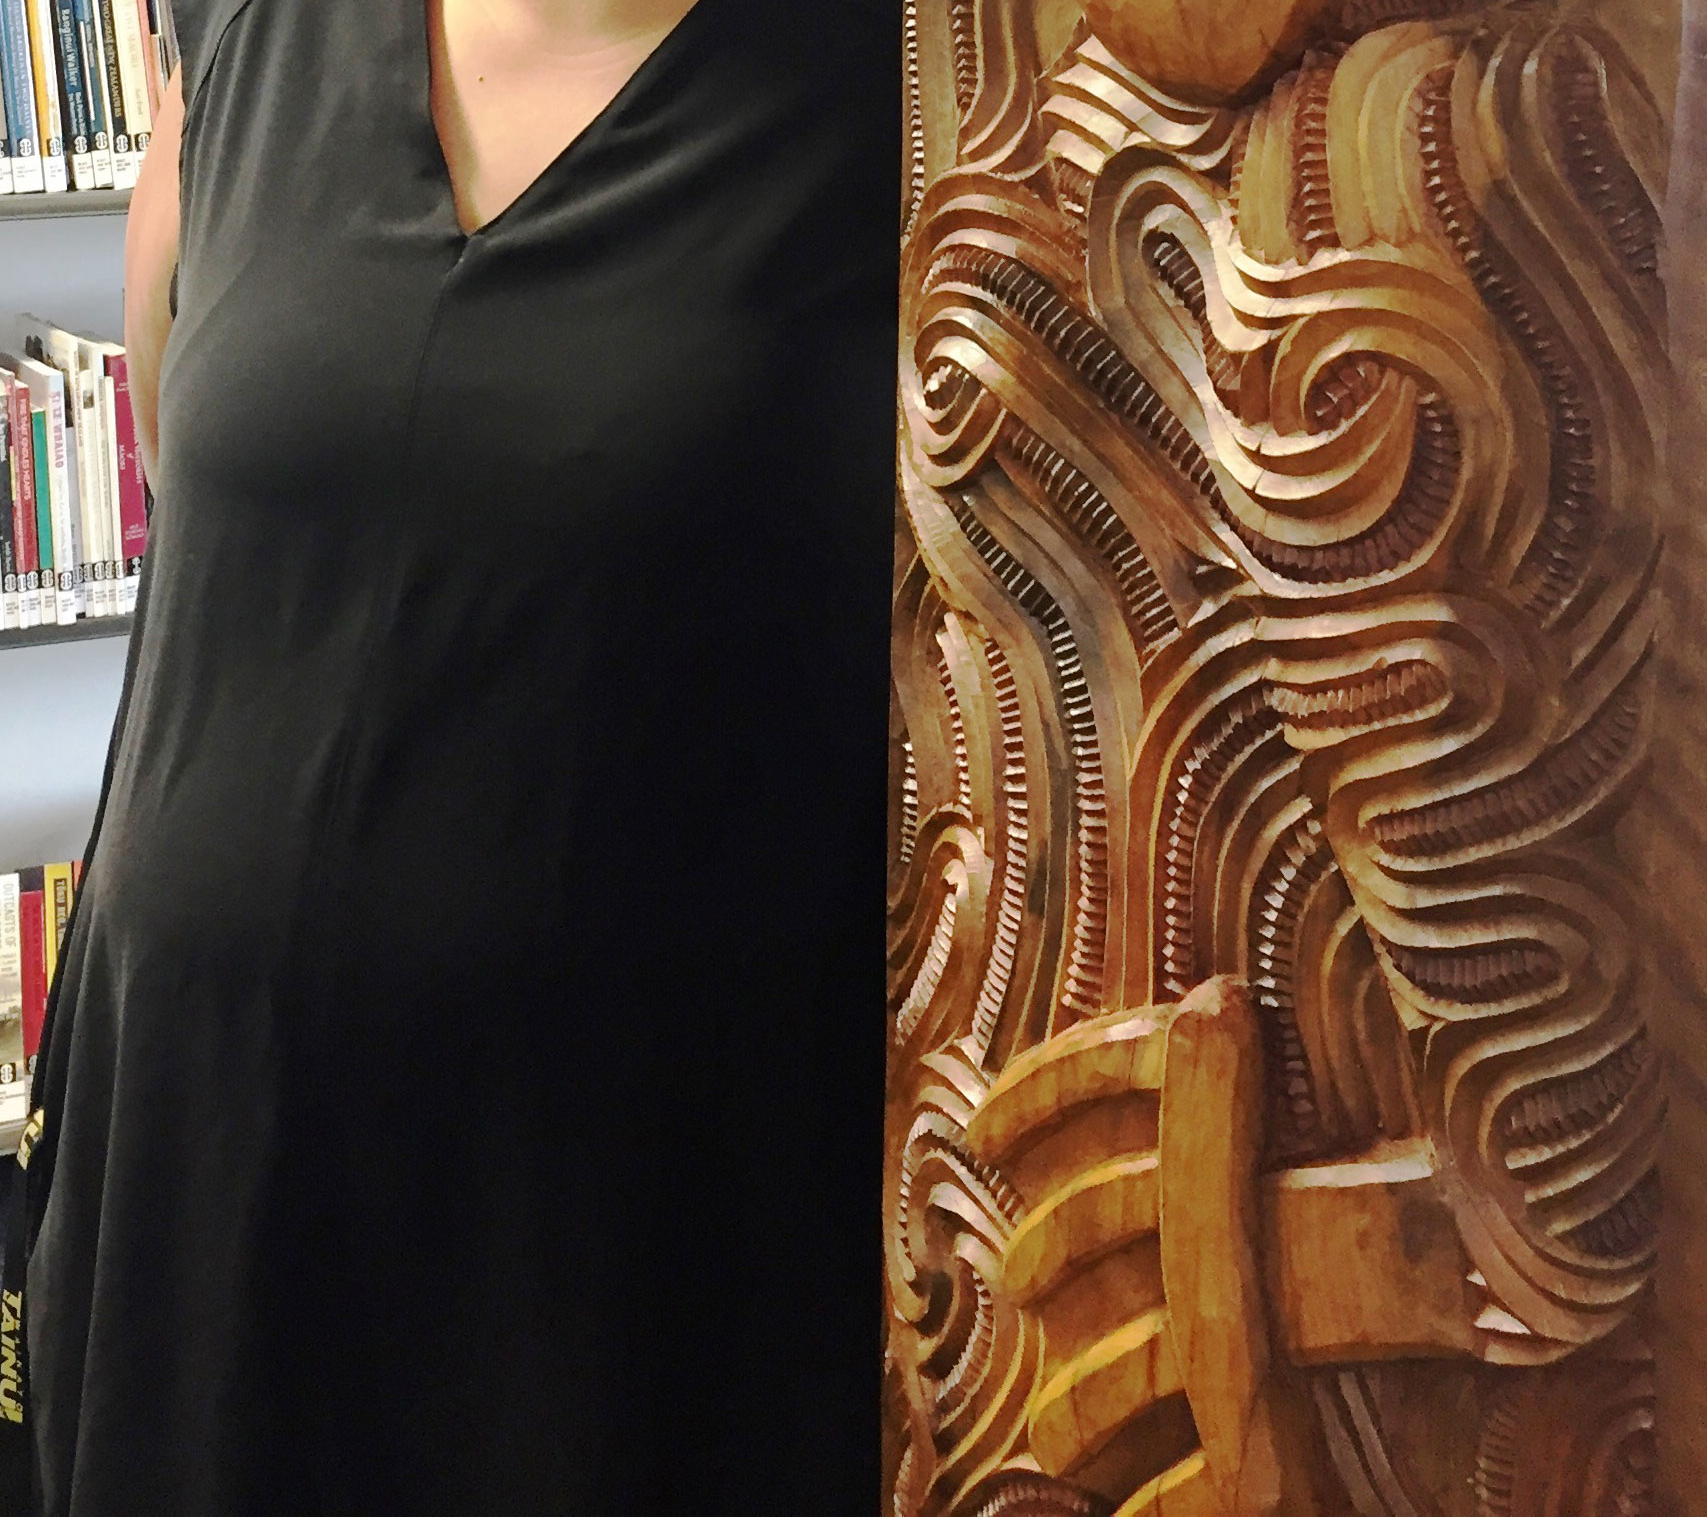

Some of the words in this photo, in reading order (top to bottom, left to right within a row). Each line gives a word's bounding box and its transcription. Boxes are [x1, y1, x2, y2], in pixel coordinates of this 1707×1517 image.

[66, 52, 78, 86] Walker
[19, 398, 28, 414] FIRE
[20, 417, 28, 435] THAT
[20, 436, 30, 469] KINDLES
[53, 424, 64, 468] WHAIAO
[22, 470, 32, 500] HEARTS
[3, 883, 16, 934] OUTCASTS
